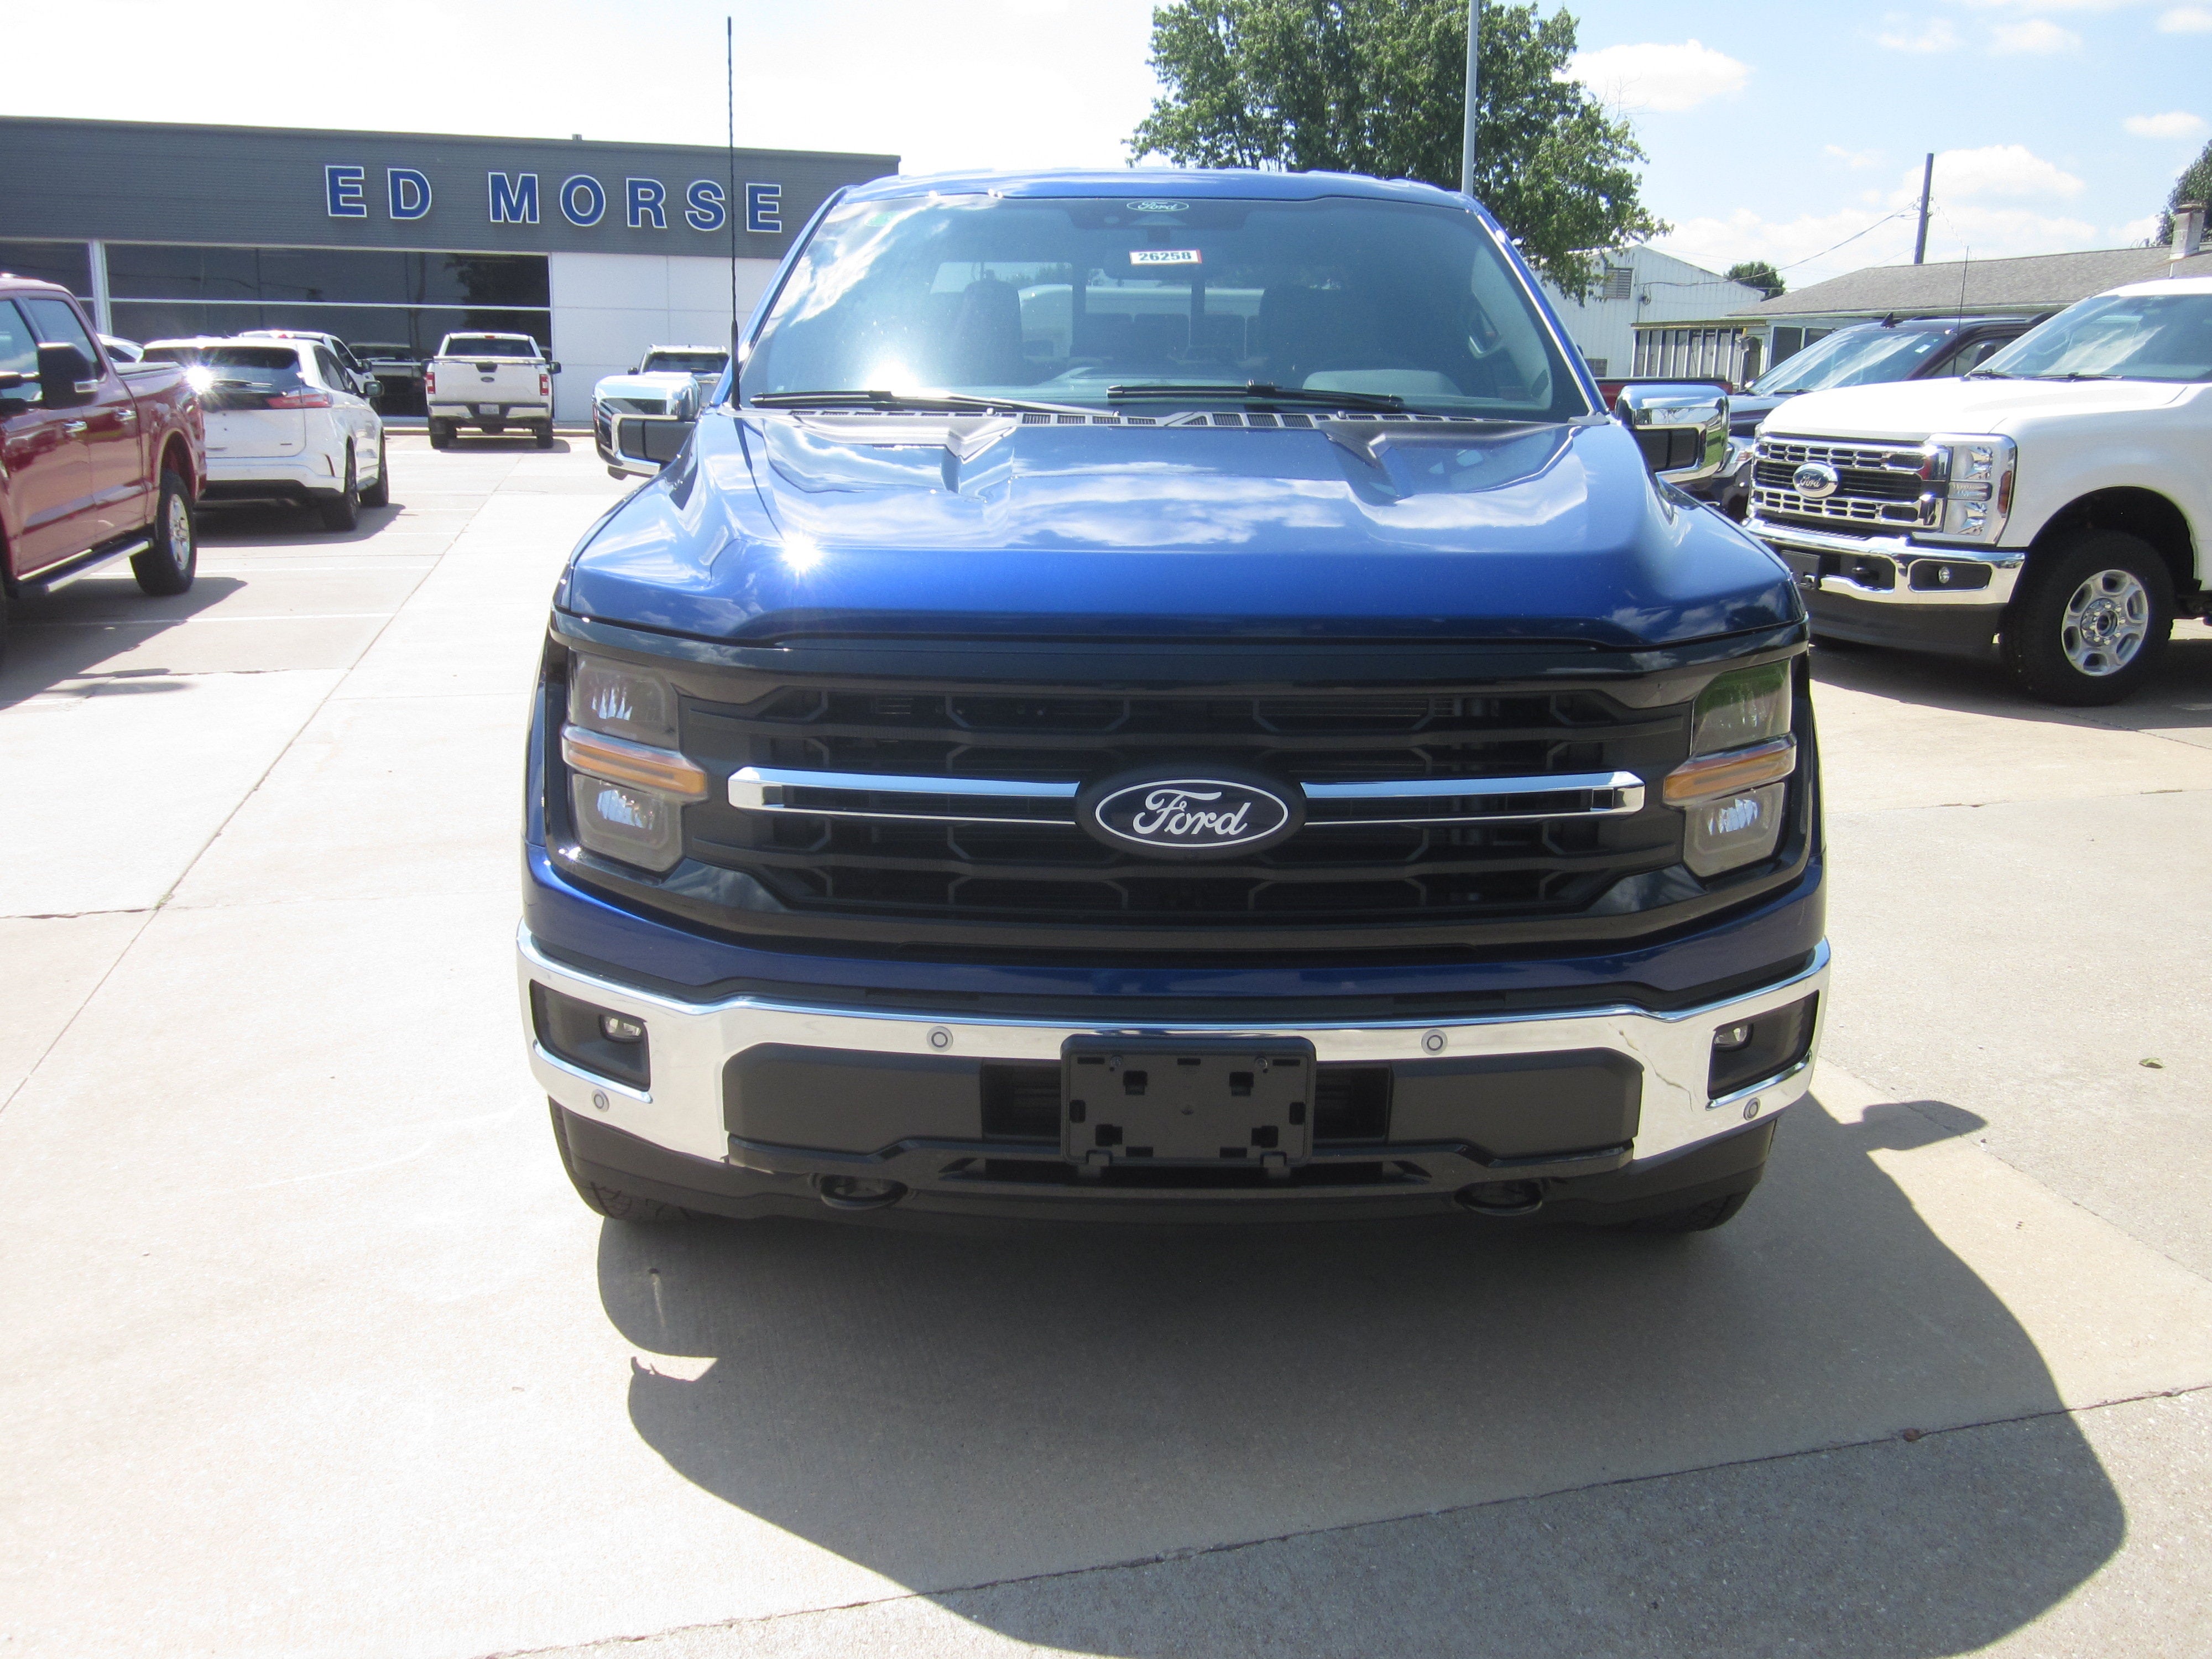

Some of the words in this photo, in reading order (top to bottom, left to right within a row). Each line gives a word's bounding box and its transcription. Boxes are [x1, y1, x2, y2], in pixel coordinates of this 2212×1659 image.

[325, 165, 432, 220] ED
[487, 171, 782, 233] MORSE
[1138, 201, 1178, 210] Ford
[1139, 252, 1192, 261] 26258
[1799, 472, 1822, 487] Ford
[1133, 789, 1251, 835] Ford
